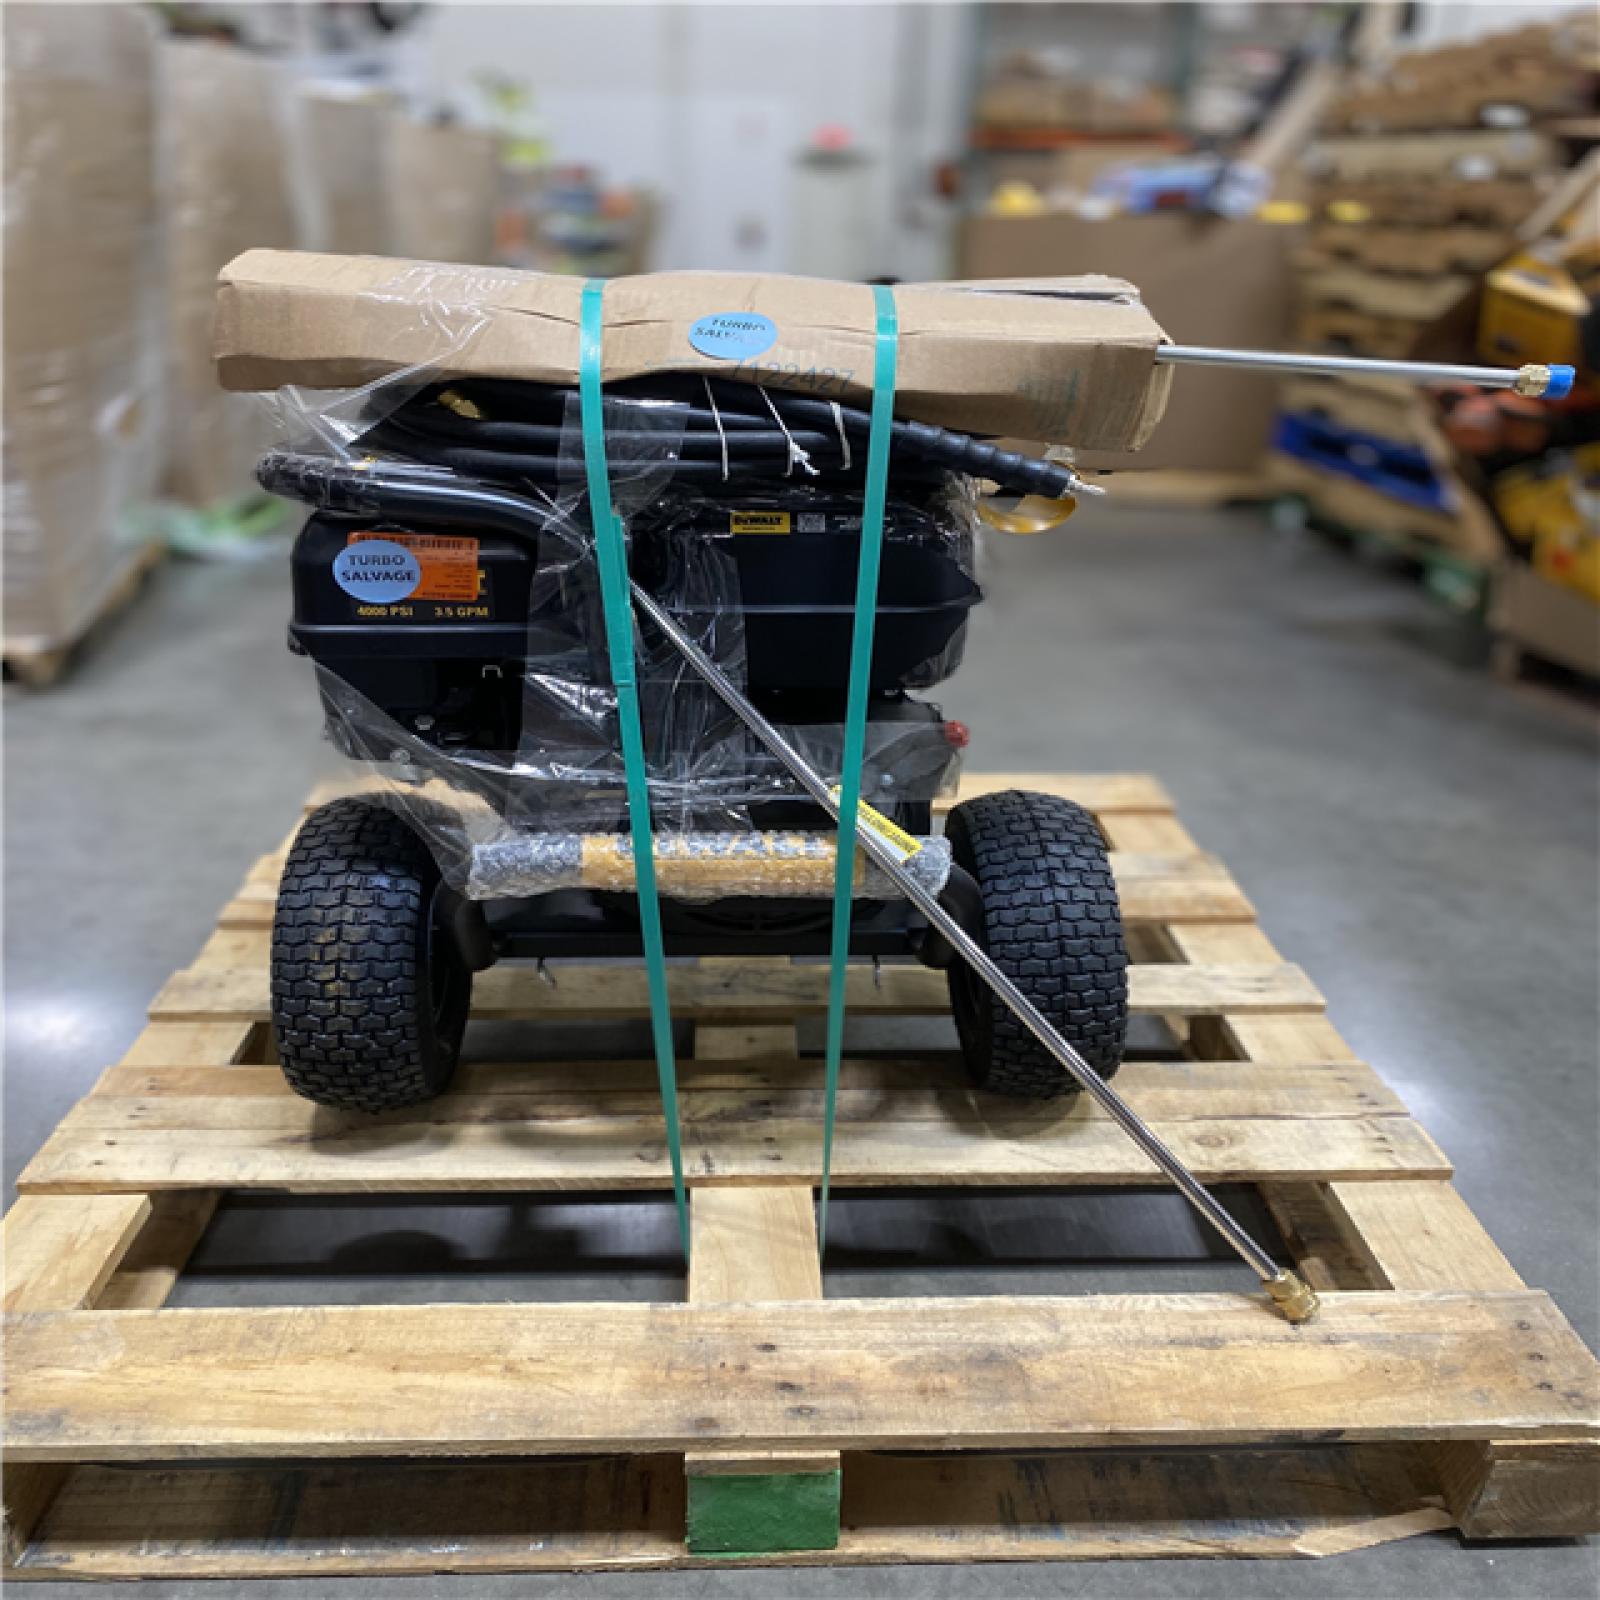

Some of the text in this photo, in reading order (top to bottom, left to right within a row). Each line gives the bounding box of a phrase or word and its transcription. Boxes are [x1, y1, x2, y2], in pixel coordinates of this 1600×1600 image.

[347, 554, 405, 566] TURBO
[341, 569, 415, 582] SALVAGE
[389, 606, 414, 617] PSI
[456, 606, 489, 617] GPM
